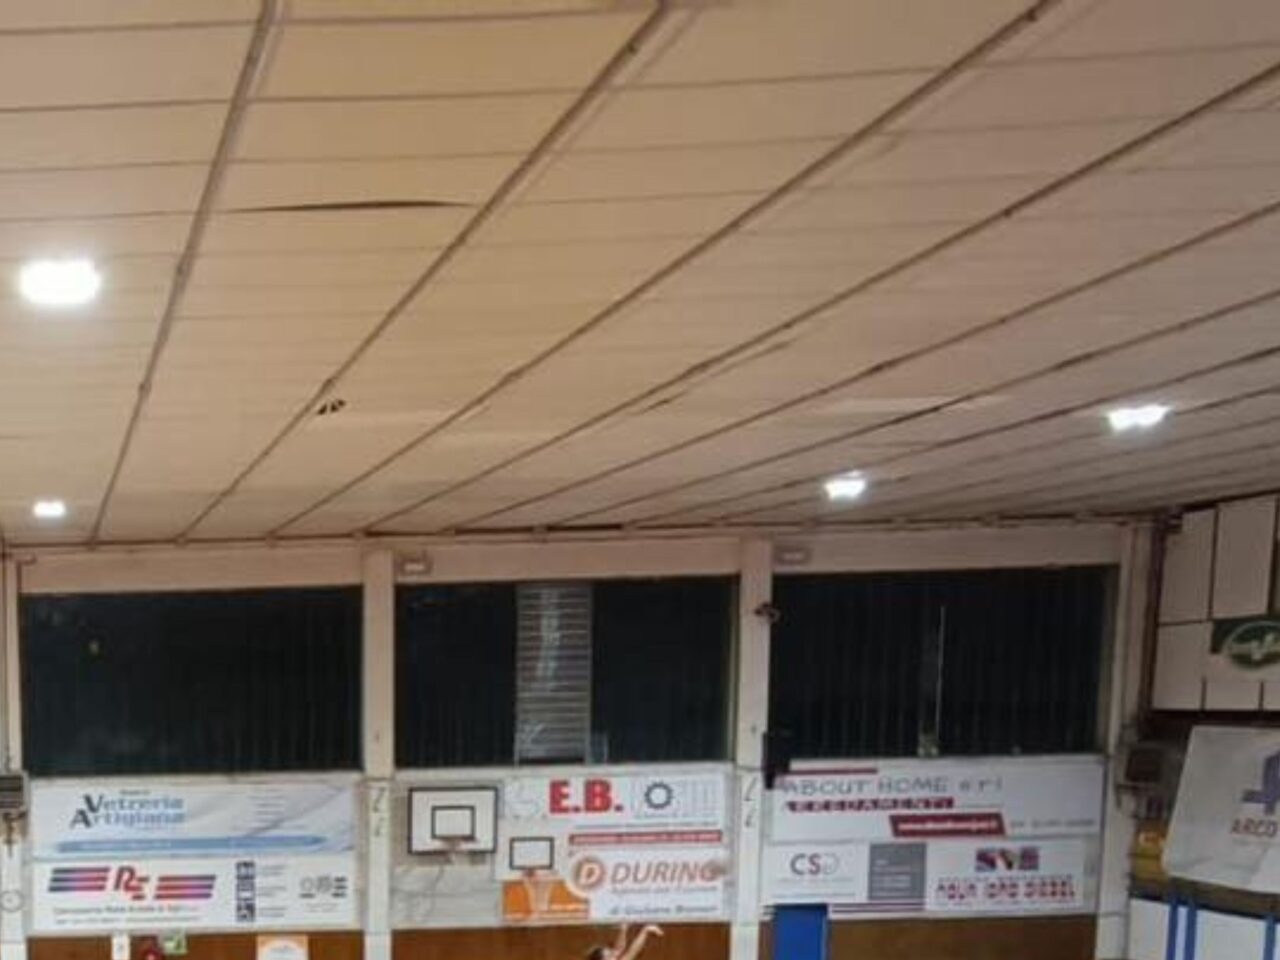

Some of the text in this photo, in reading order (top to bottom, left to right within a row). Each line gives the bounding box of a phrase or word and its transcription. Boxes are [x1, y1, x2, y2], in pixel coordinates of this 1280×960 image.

[549, 778, 624, 814] E.B.
[878, 777, 949, 793] HOME
[611, 860, 722, 884] DURING
